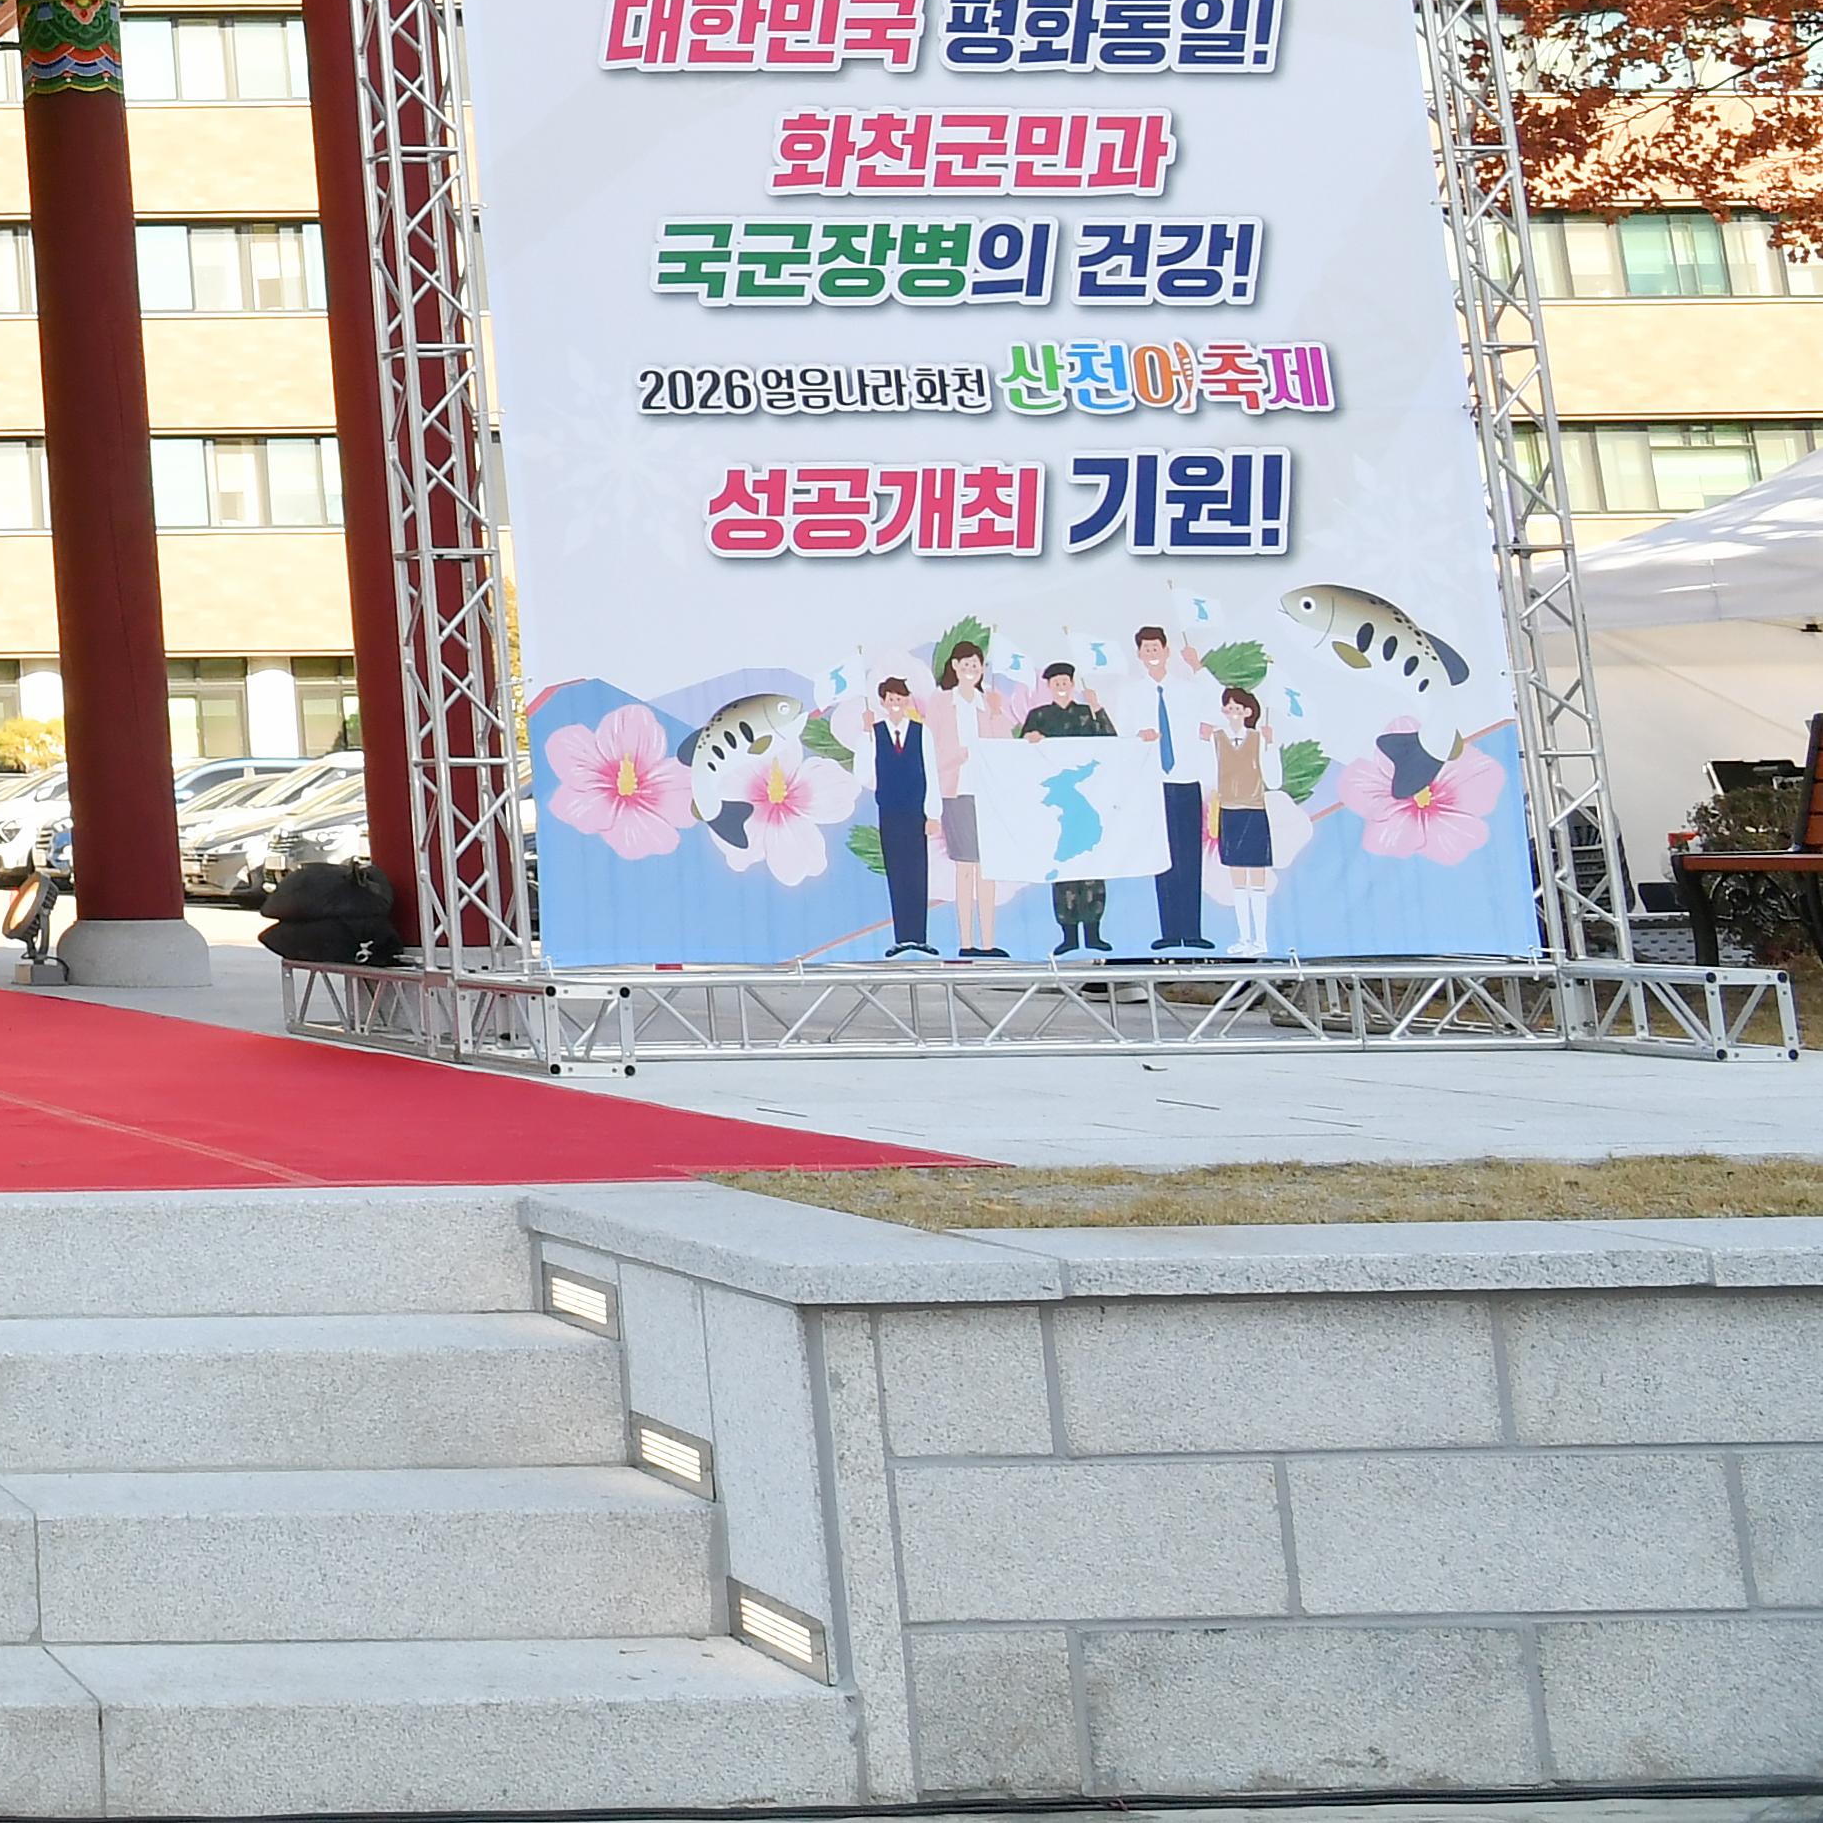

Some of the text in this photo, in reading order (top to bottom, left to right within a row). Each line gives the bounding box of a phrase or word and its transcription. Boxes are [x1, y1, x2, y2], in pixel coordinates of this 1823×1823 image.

[776, 113, 1170, 190] 화천군민과
[657, 223, 1258, 301] 국군장병의 건강!
[640, 369, 751, 410] 2026
[1003, 343, 1329, 410] 산천어축제
[709, 454, 1283, 550] 성공개최 기원!
